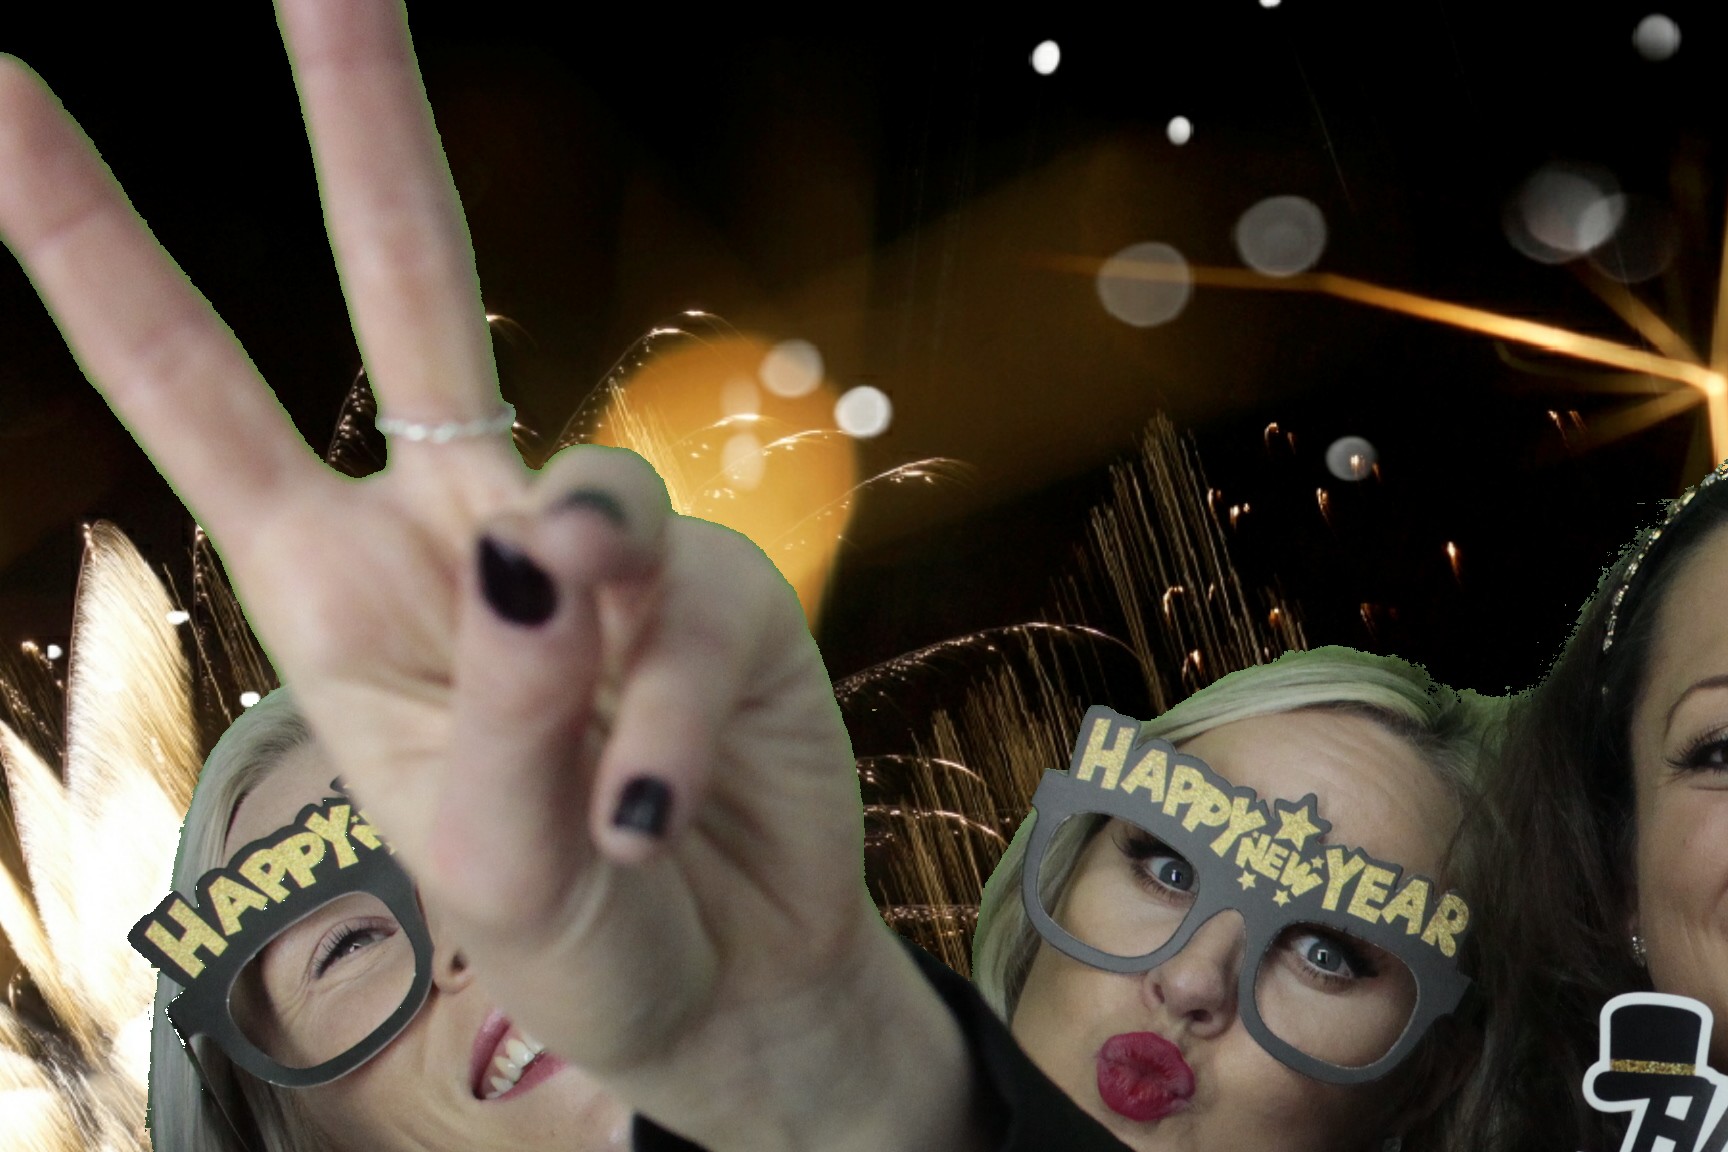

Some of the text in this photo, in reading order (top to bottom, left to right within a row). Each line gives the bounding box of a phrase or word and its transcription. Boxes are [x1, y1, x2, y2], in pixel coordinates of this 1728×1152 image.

[144, 804, 359, 979] HAPPY
[1076, 718, 1470, 958] HAPPY NEW YEAR
